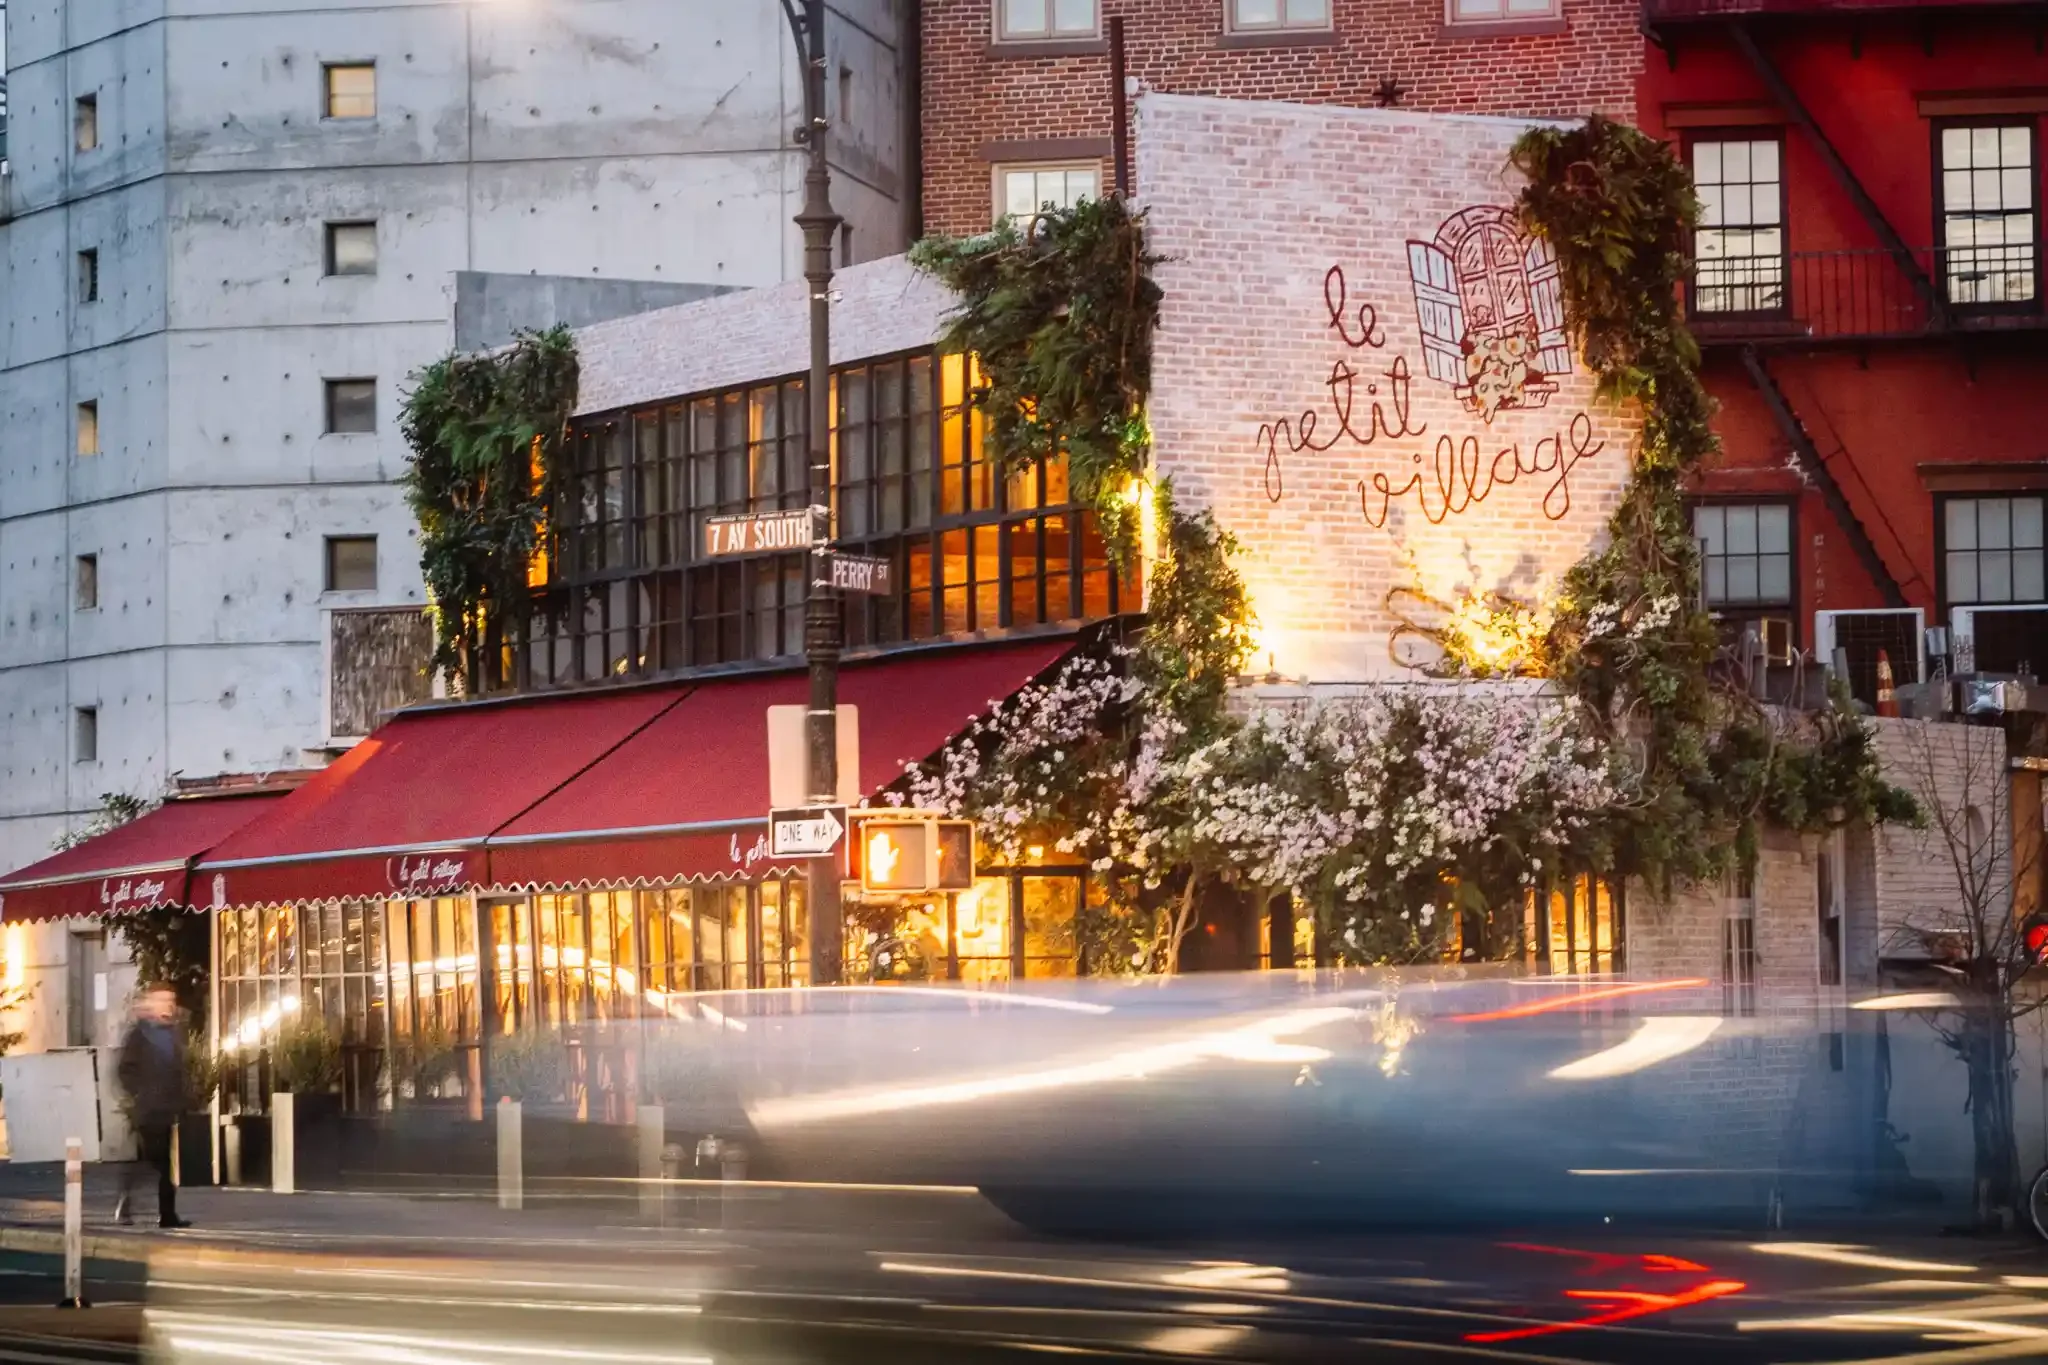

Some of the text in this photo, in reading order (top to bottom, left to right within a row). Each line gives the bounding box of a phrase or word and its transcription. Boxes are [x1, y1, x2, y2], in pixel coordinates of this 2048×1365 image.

[1325, 264, 1386, 349] le
[1256, 355, 1428, 503] petit
[1357, 412, 1605, 528] village
[709, 517, 807, 554] 7 AV SOUTH
[832, 559, 889, 591] PERRY ST
[781, 823, 835, 843] ONE WAY
